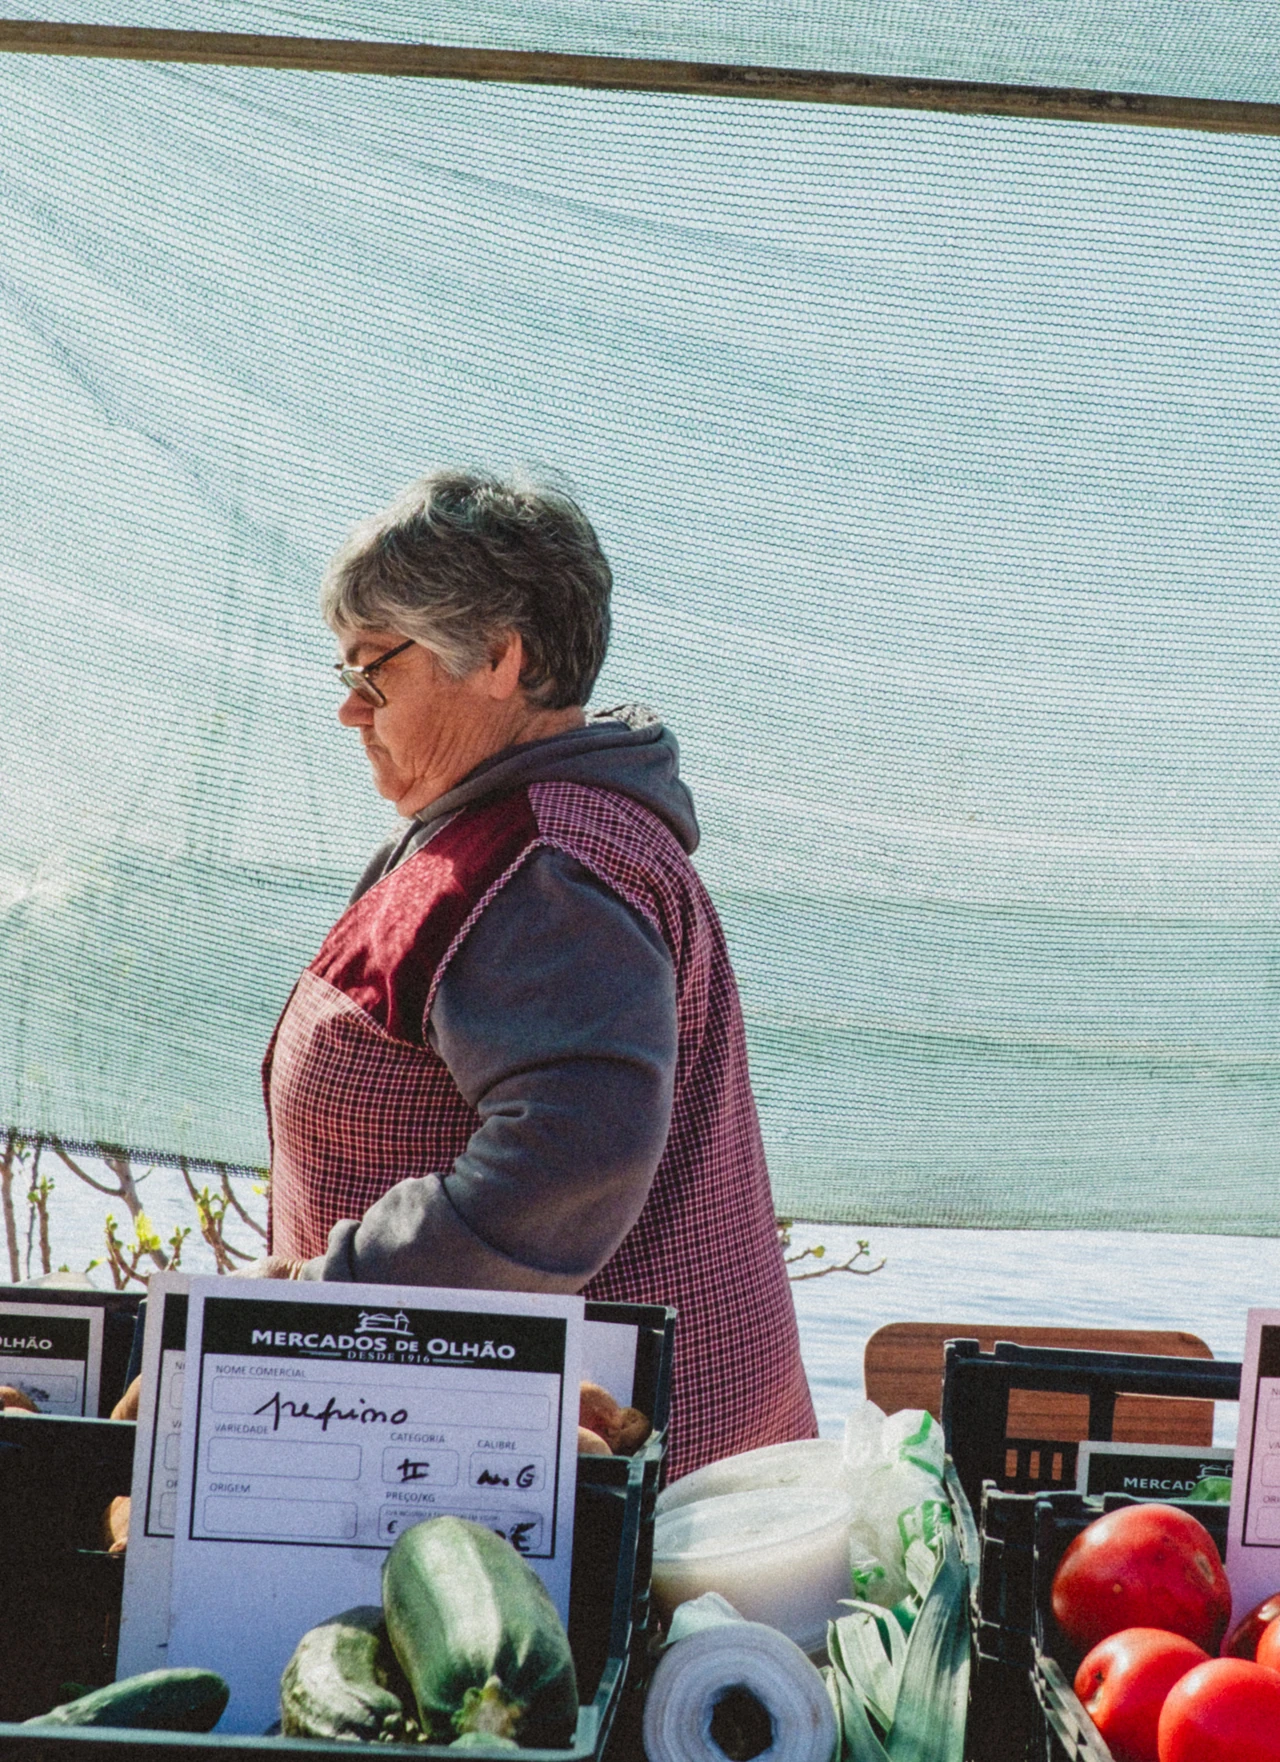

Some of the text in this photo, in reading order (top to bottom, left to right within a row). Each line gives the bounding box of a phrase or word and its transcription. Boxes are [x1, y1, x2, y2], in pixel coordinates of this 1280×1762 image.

[0, 1336, 53, 1350] LHÃO
[252, 1330, 516, 1359] MERCADOS DE OLHÃO
[348, 1352, 430, 1363] DESDE 1916
[216, 1365, 306, 1378] NOME COMERCIAL
[215, 1424, 268, 1435] VARIEDADE
[390, 1433, 445, 1443] CATEGORIA
[478, 1440, 517, 1450] CALIBRE
[209, 1482, 251, 1493] ORIGEM
[1123, 1477, 1196, 1491] MERCAD
[386, 1491, 435, 1503] PREÇO/KG
